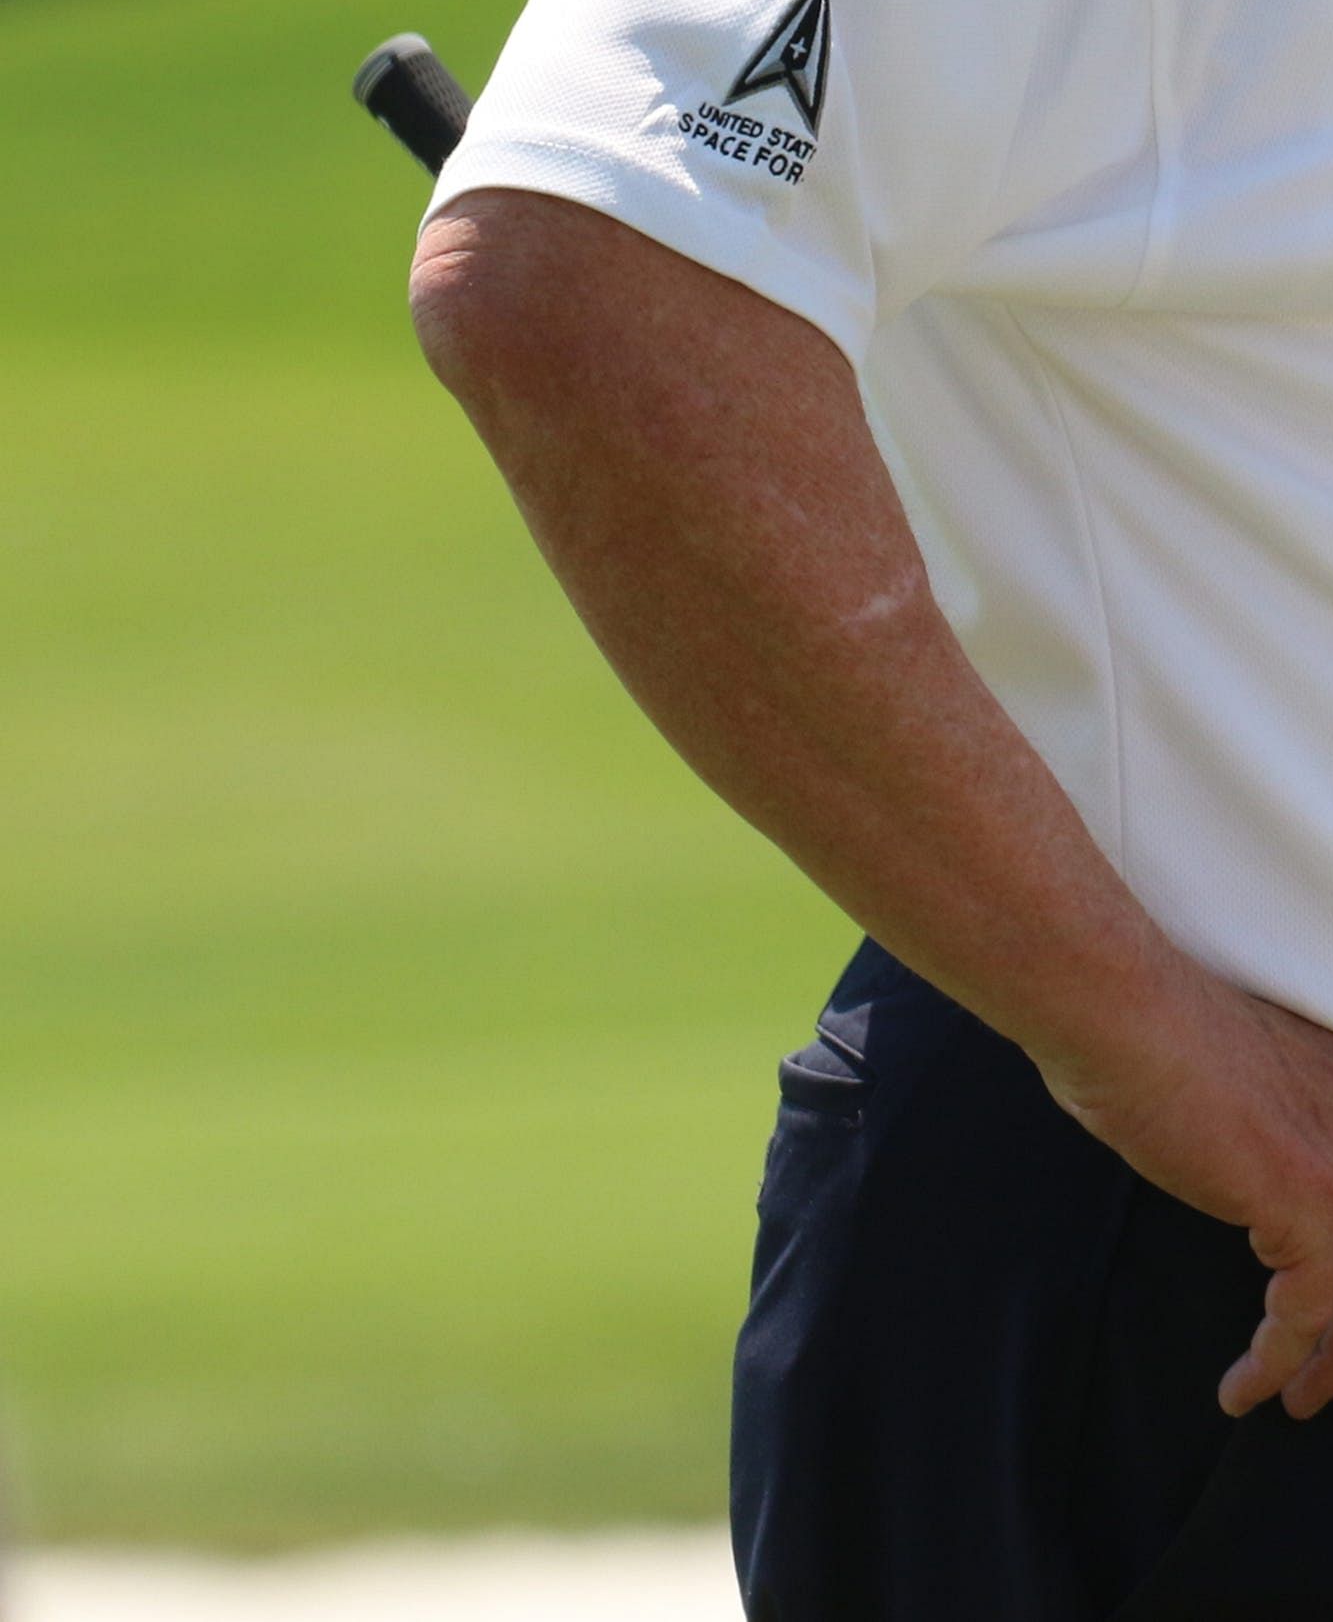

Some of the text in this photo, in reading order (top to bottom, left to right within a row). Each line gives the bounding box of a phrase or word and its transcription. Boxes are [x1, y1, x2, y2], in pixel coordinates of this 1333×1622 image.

[677, 112, 805, 186] SPACE FOR
[698, 101, 816, 163] UNITED STAT
